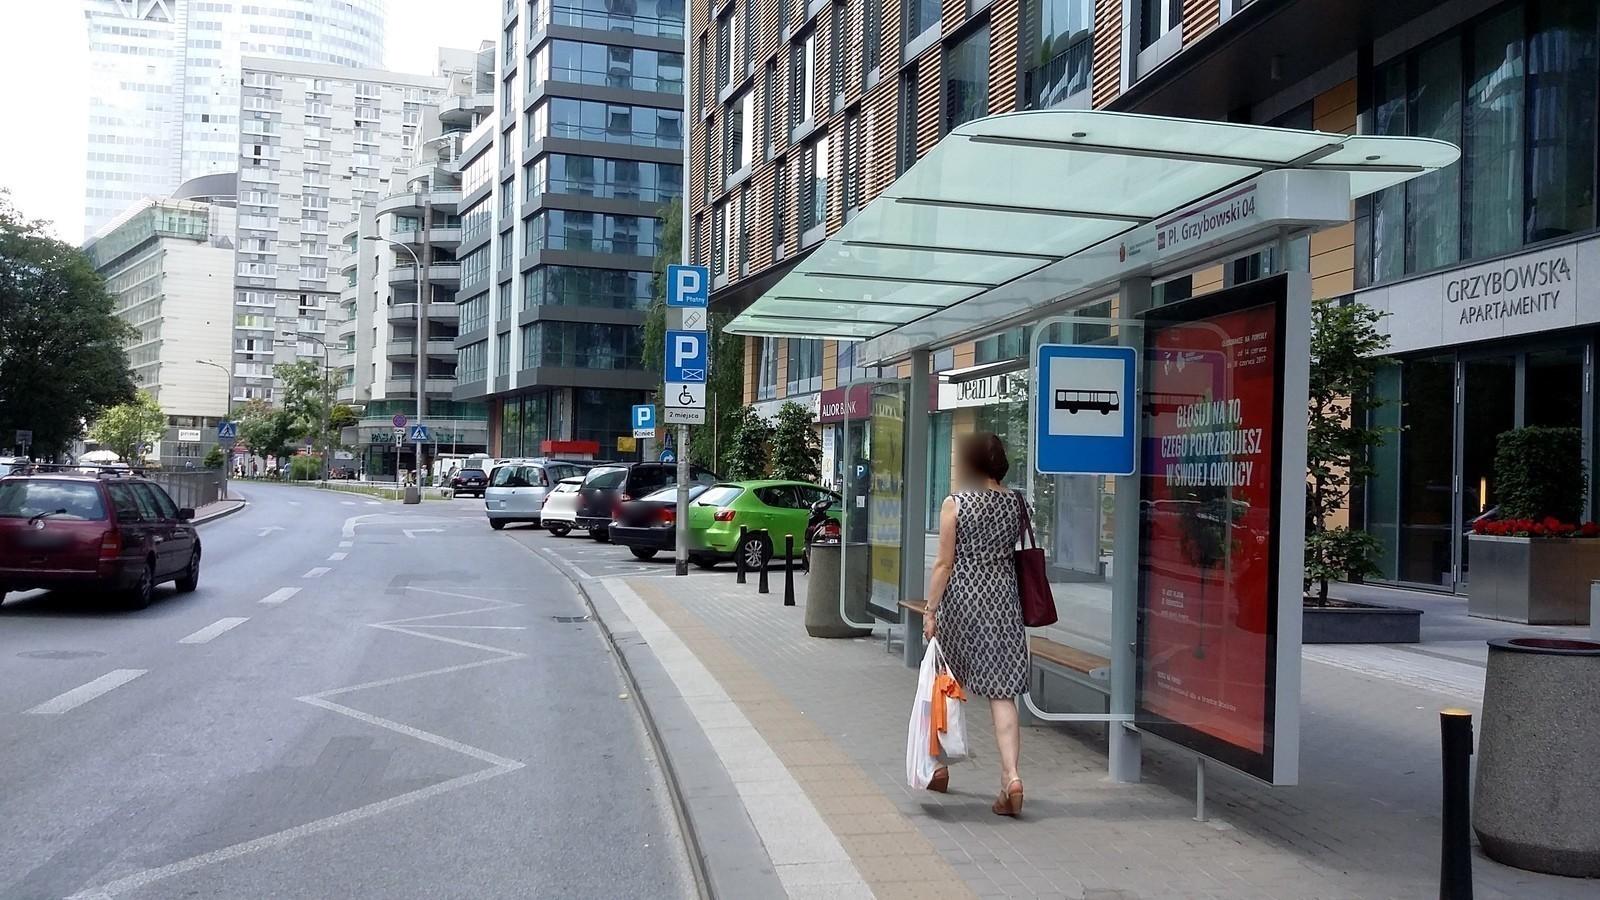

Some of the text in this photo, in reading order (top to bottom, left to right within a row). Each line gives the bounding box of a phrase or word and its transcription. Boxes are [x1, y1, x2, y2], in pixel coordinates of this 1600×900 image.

[1168, 226, 1178, 246] Pl.
[1182, 201, 1240, 240] Grzybowski
[1242, 196, 1255, 218] 04
[676, 269, 700, 301] P
[1447, 256, 1571, 303] GRZYBOWSKA
[1460, 290, 1560, 325] APARTAMENTY
[675, 335, 698, 367] P
[637, 407, 651, 427] P
[822, 403, 840, 417] ALIOR
[1176, 398, 1243, 428] GŁOSUJ NA TO,
[1161, 428, 1262, 458] CZEGO POTRZEBUJESZ
[1166, 460, 1253, 487] W SWOJEJ OKOLICY
